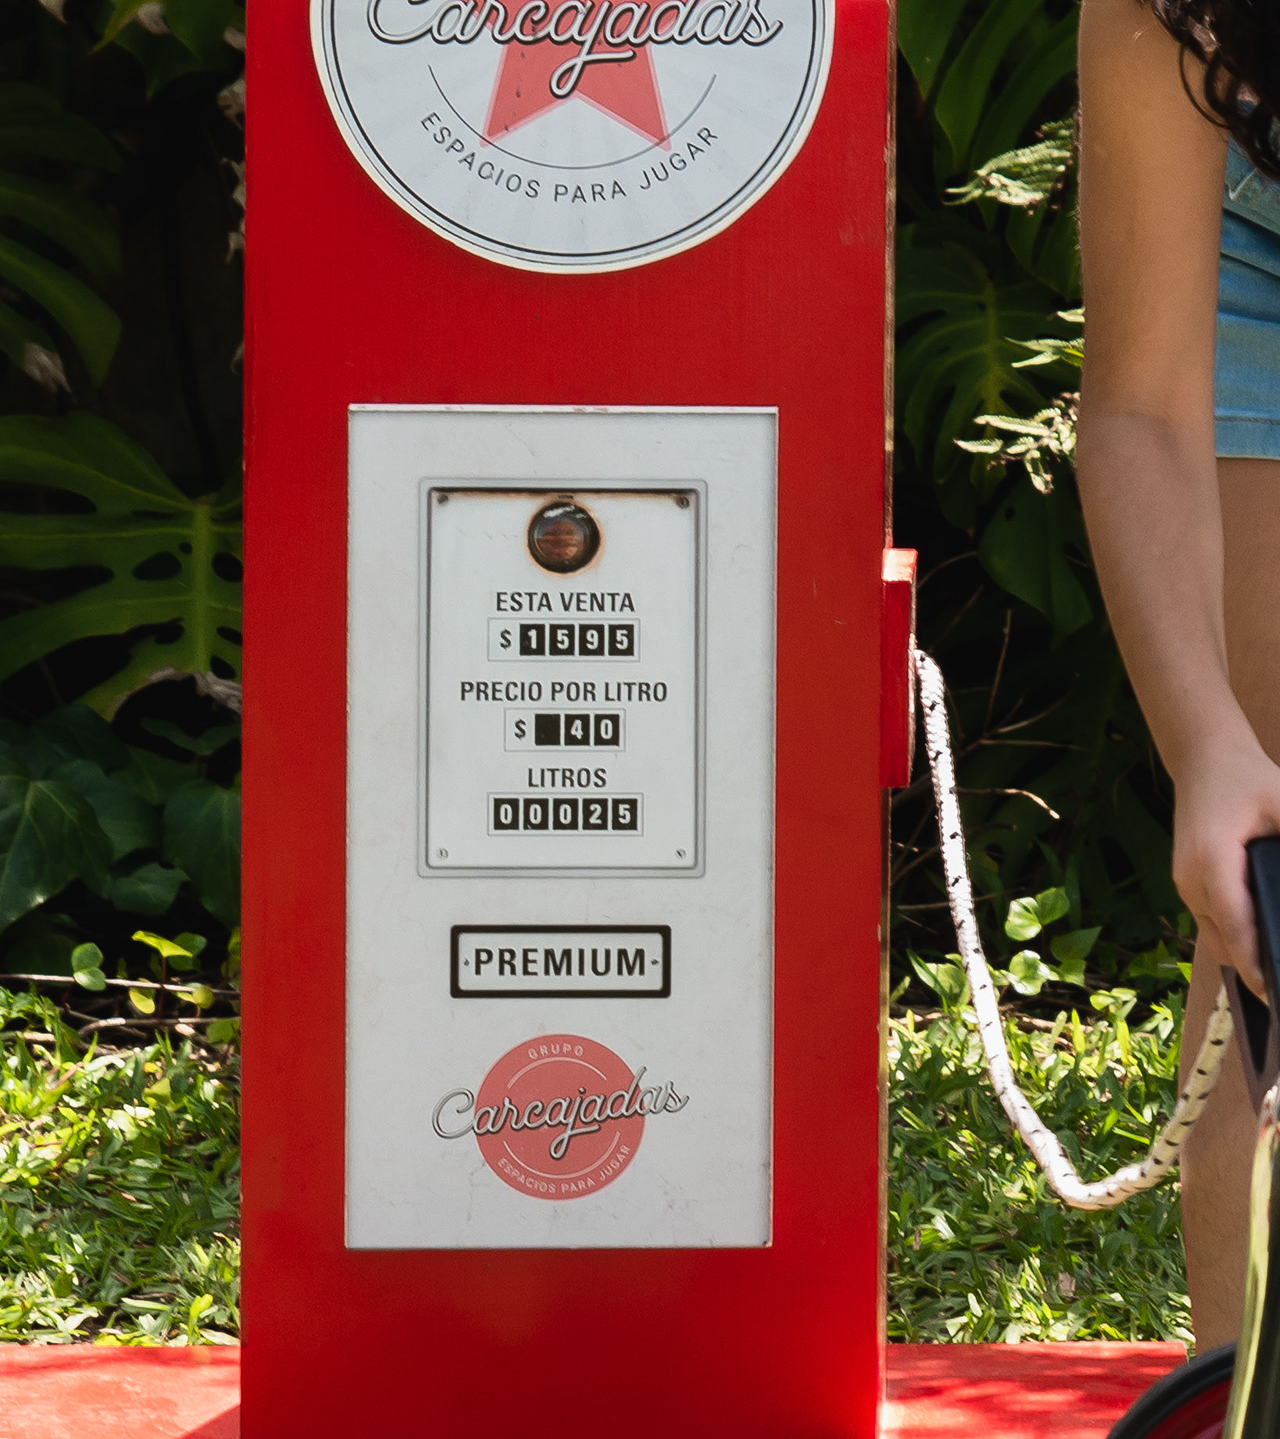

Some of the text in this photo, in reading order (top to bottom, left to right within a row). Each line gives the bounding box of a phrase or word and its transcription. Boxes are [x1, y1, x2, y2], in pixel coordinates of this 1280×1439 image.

[418, 110, 719, 204] ESPACIOS PARA JUGAR
[496, 591, 636, 613] ESTA VENTA
[460, 681, 668, 703] PRECIO POR LITRO
[527, 767, 607, 789] LITROS
[474, 948, 646, 977] PREMIUM
[528, 1043, 584, 1060] GRUPO
[431, 1066, 690, 1161] Carcajadas
[497, 1144, 632, 1195] ESPACIOS PARA JUGAR
